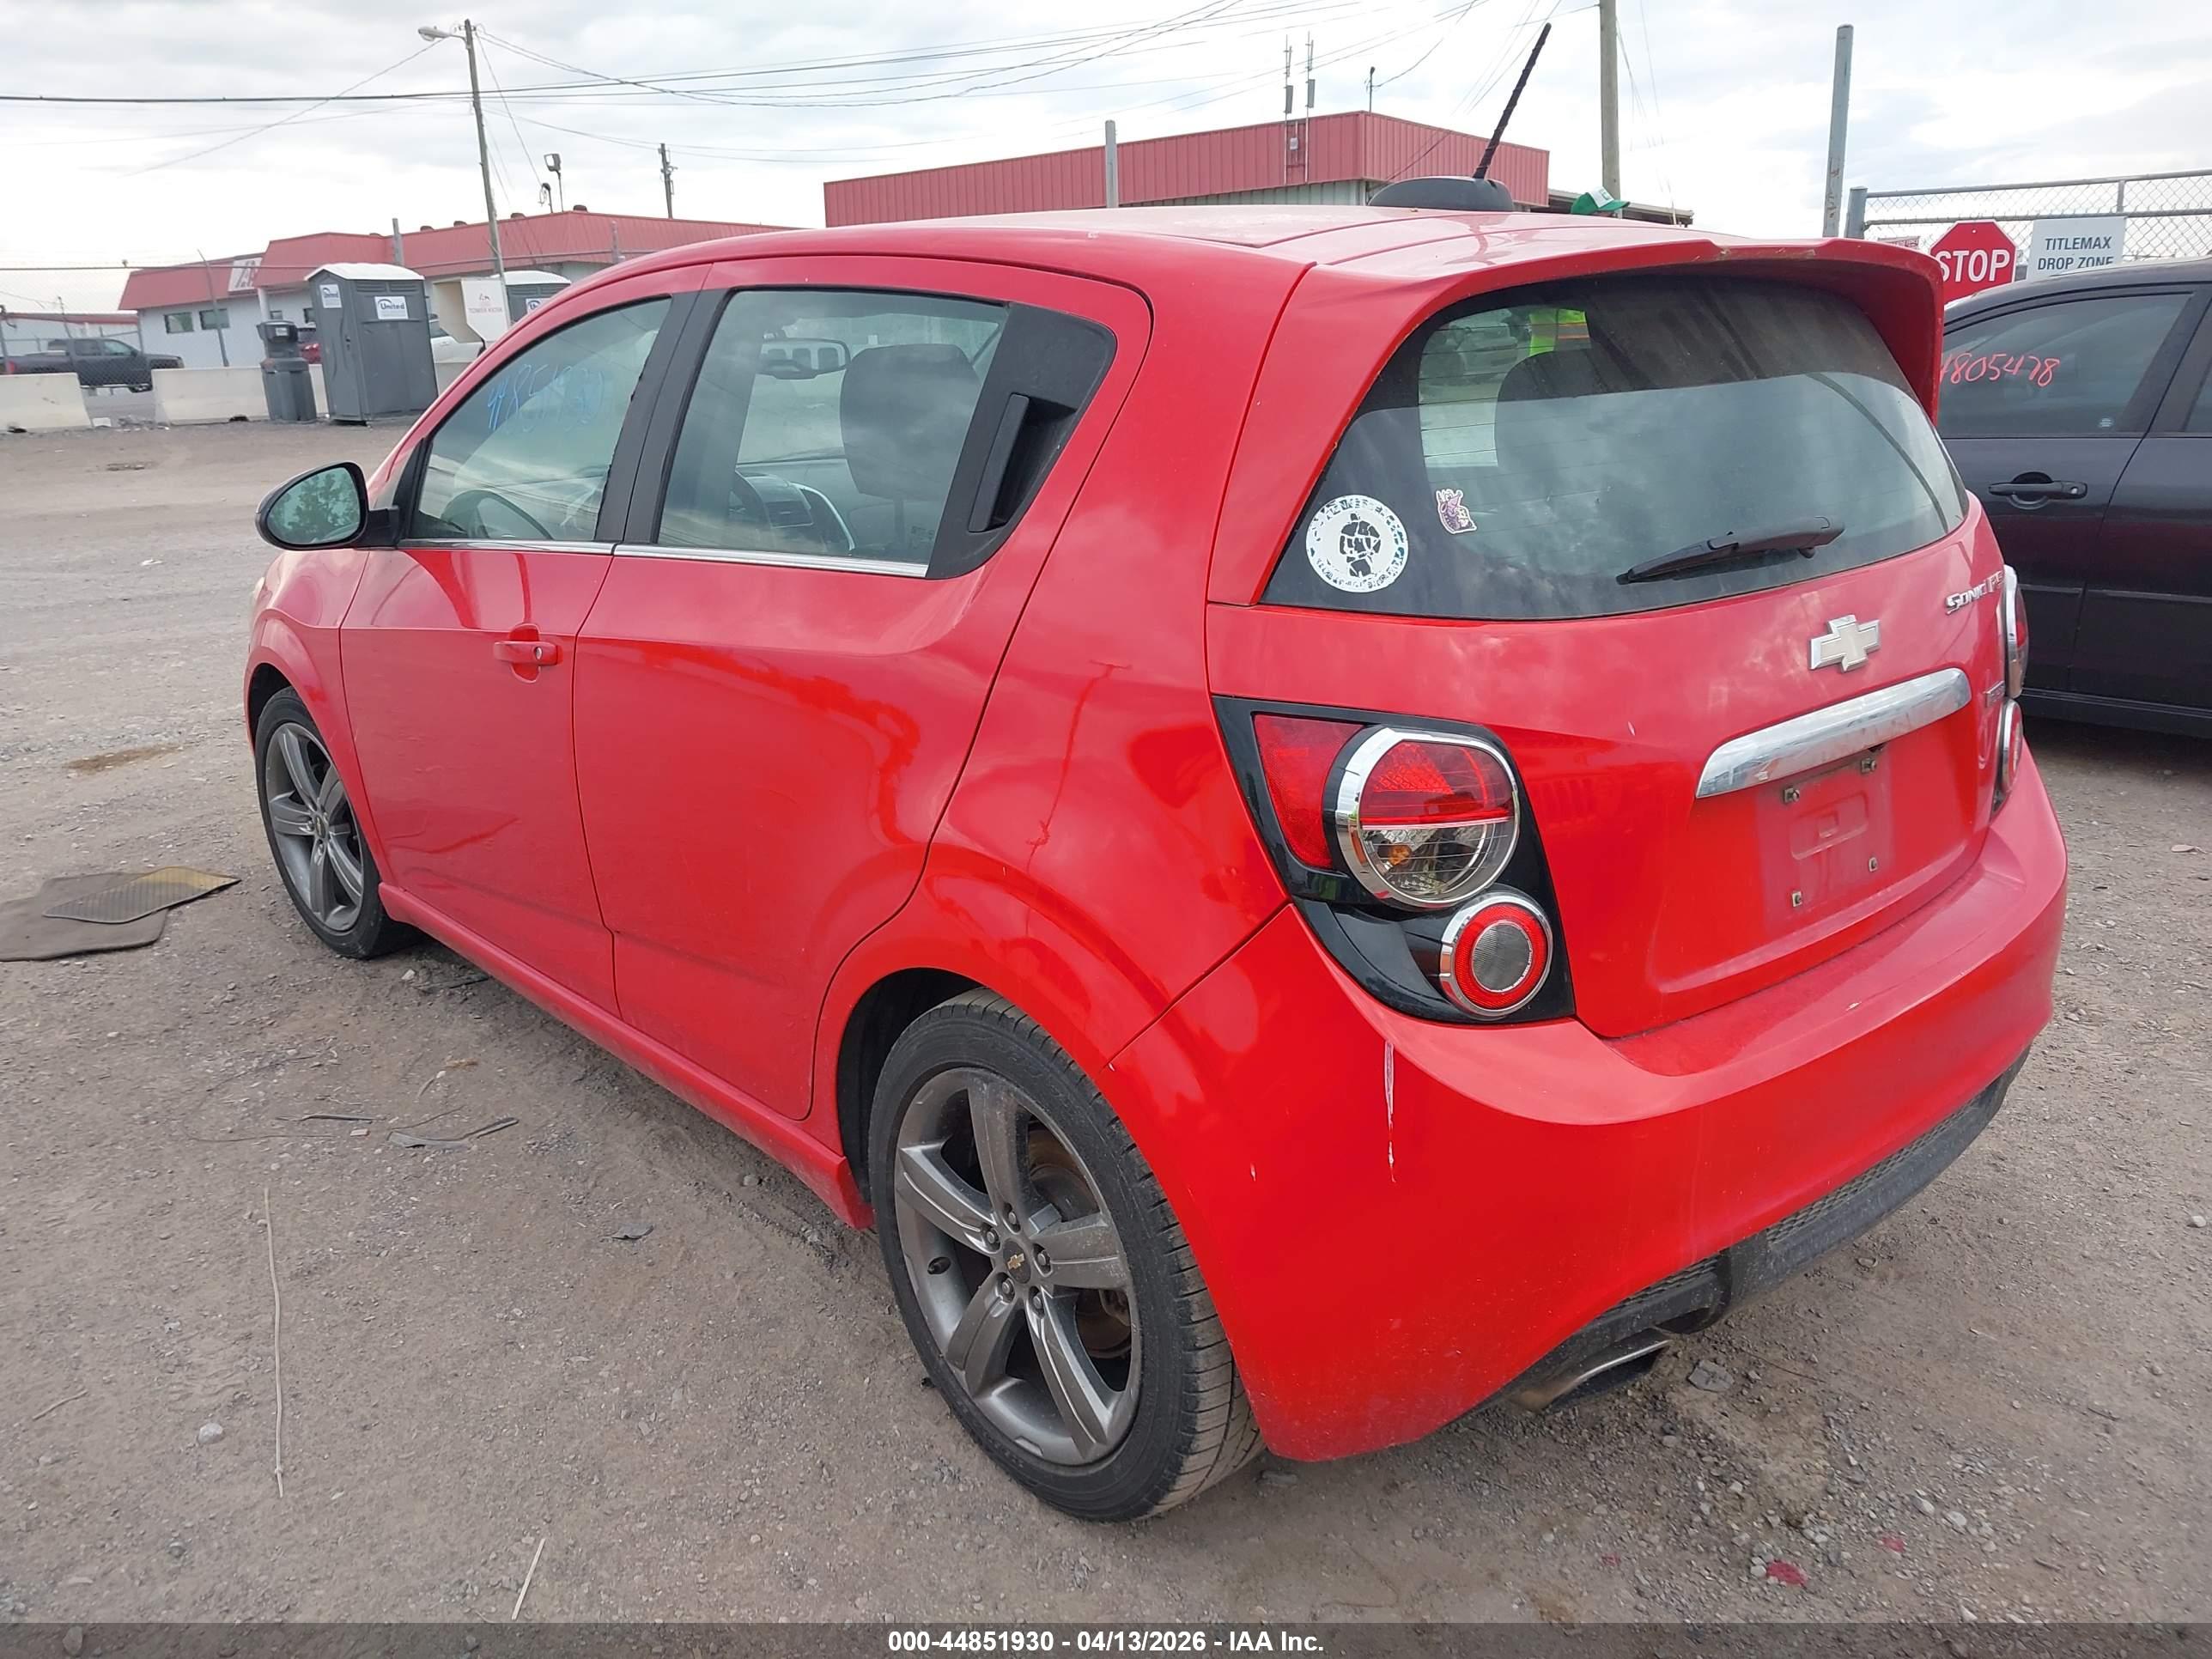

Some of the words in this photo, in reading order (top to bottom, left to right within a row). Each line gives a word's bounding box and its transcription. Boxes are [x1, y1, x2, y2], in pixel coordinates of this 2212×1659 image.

[2045, 235, 2112, 251] TITLEMAX
[1935, 248, 2011, 283] STOP
[2037, 257, 2075, 270] DROP
